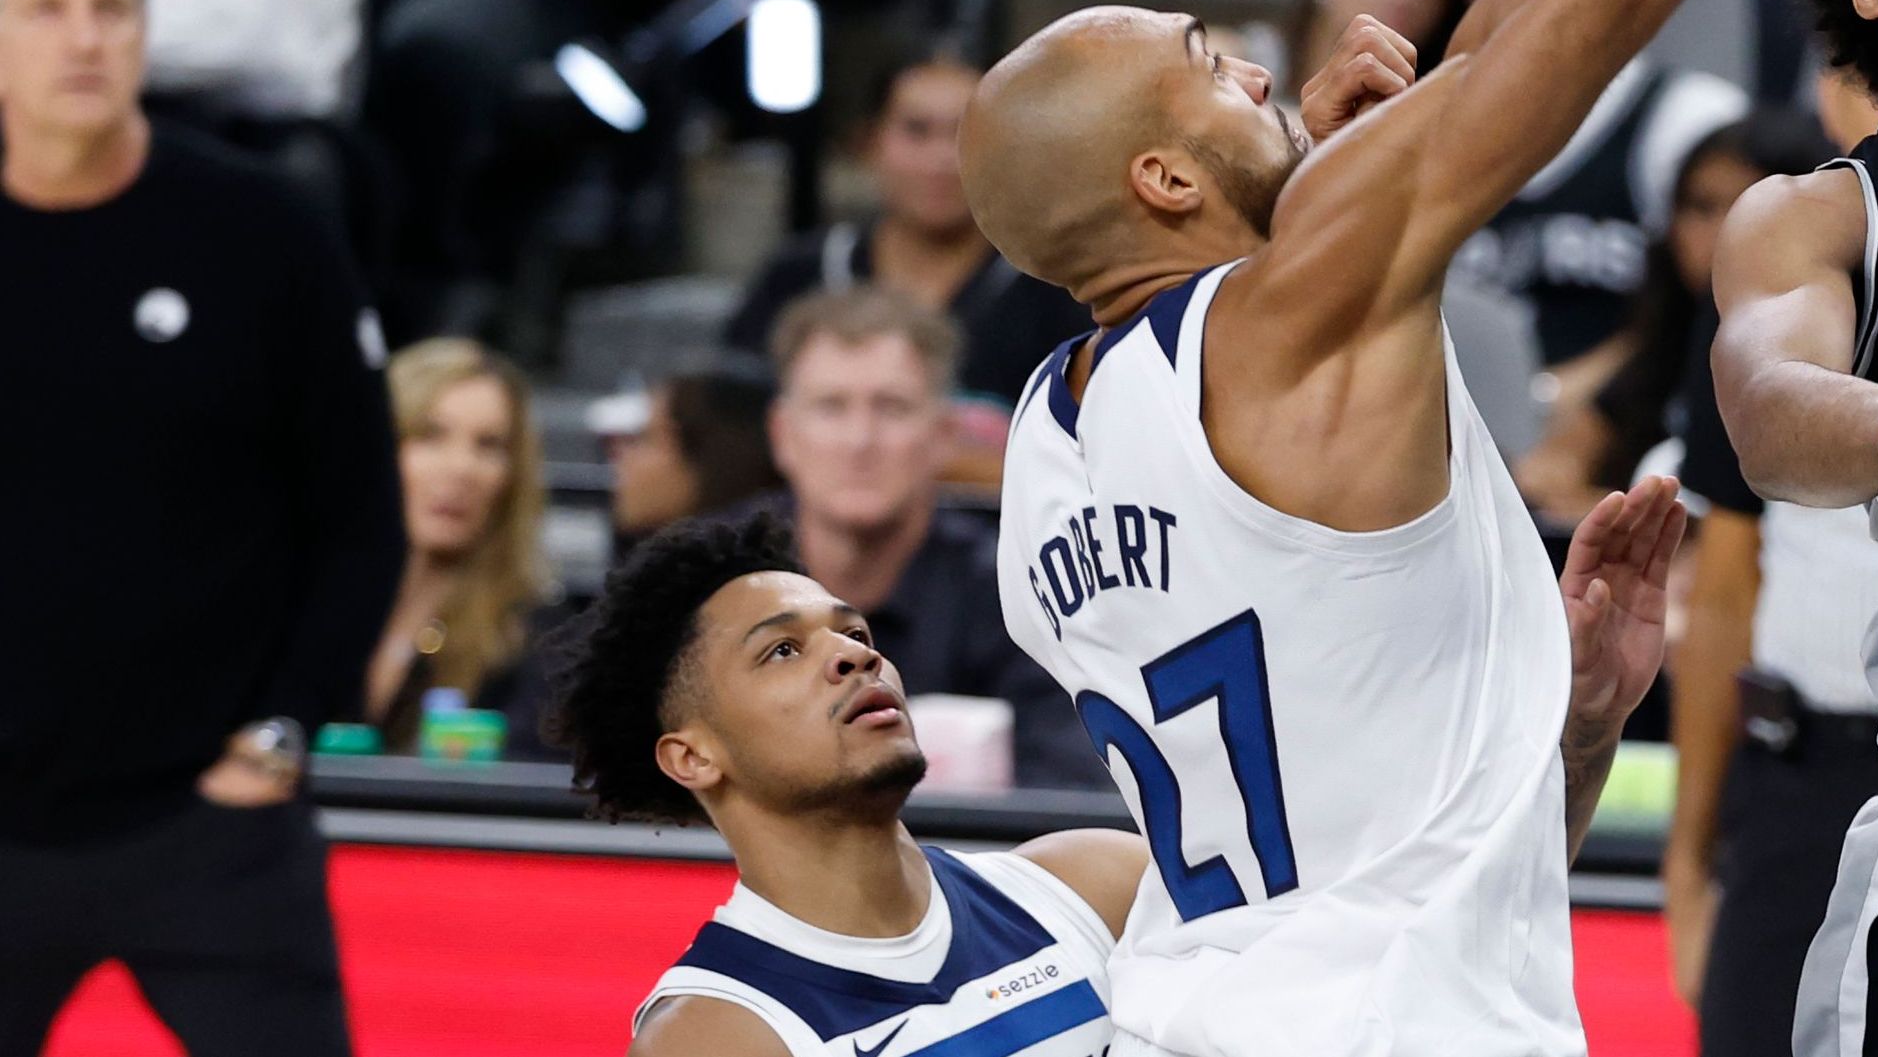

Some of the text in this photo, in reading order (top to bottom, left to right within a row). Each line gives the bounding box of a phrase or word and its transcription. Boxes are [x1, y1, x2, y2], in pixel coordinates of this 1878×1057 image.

[1028, 504, 1178, 643] GOBERT
[1074, 607, 1300, 924] 27
[1000, 963, 1060, 998] sezzle
